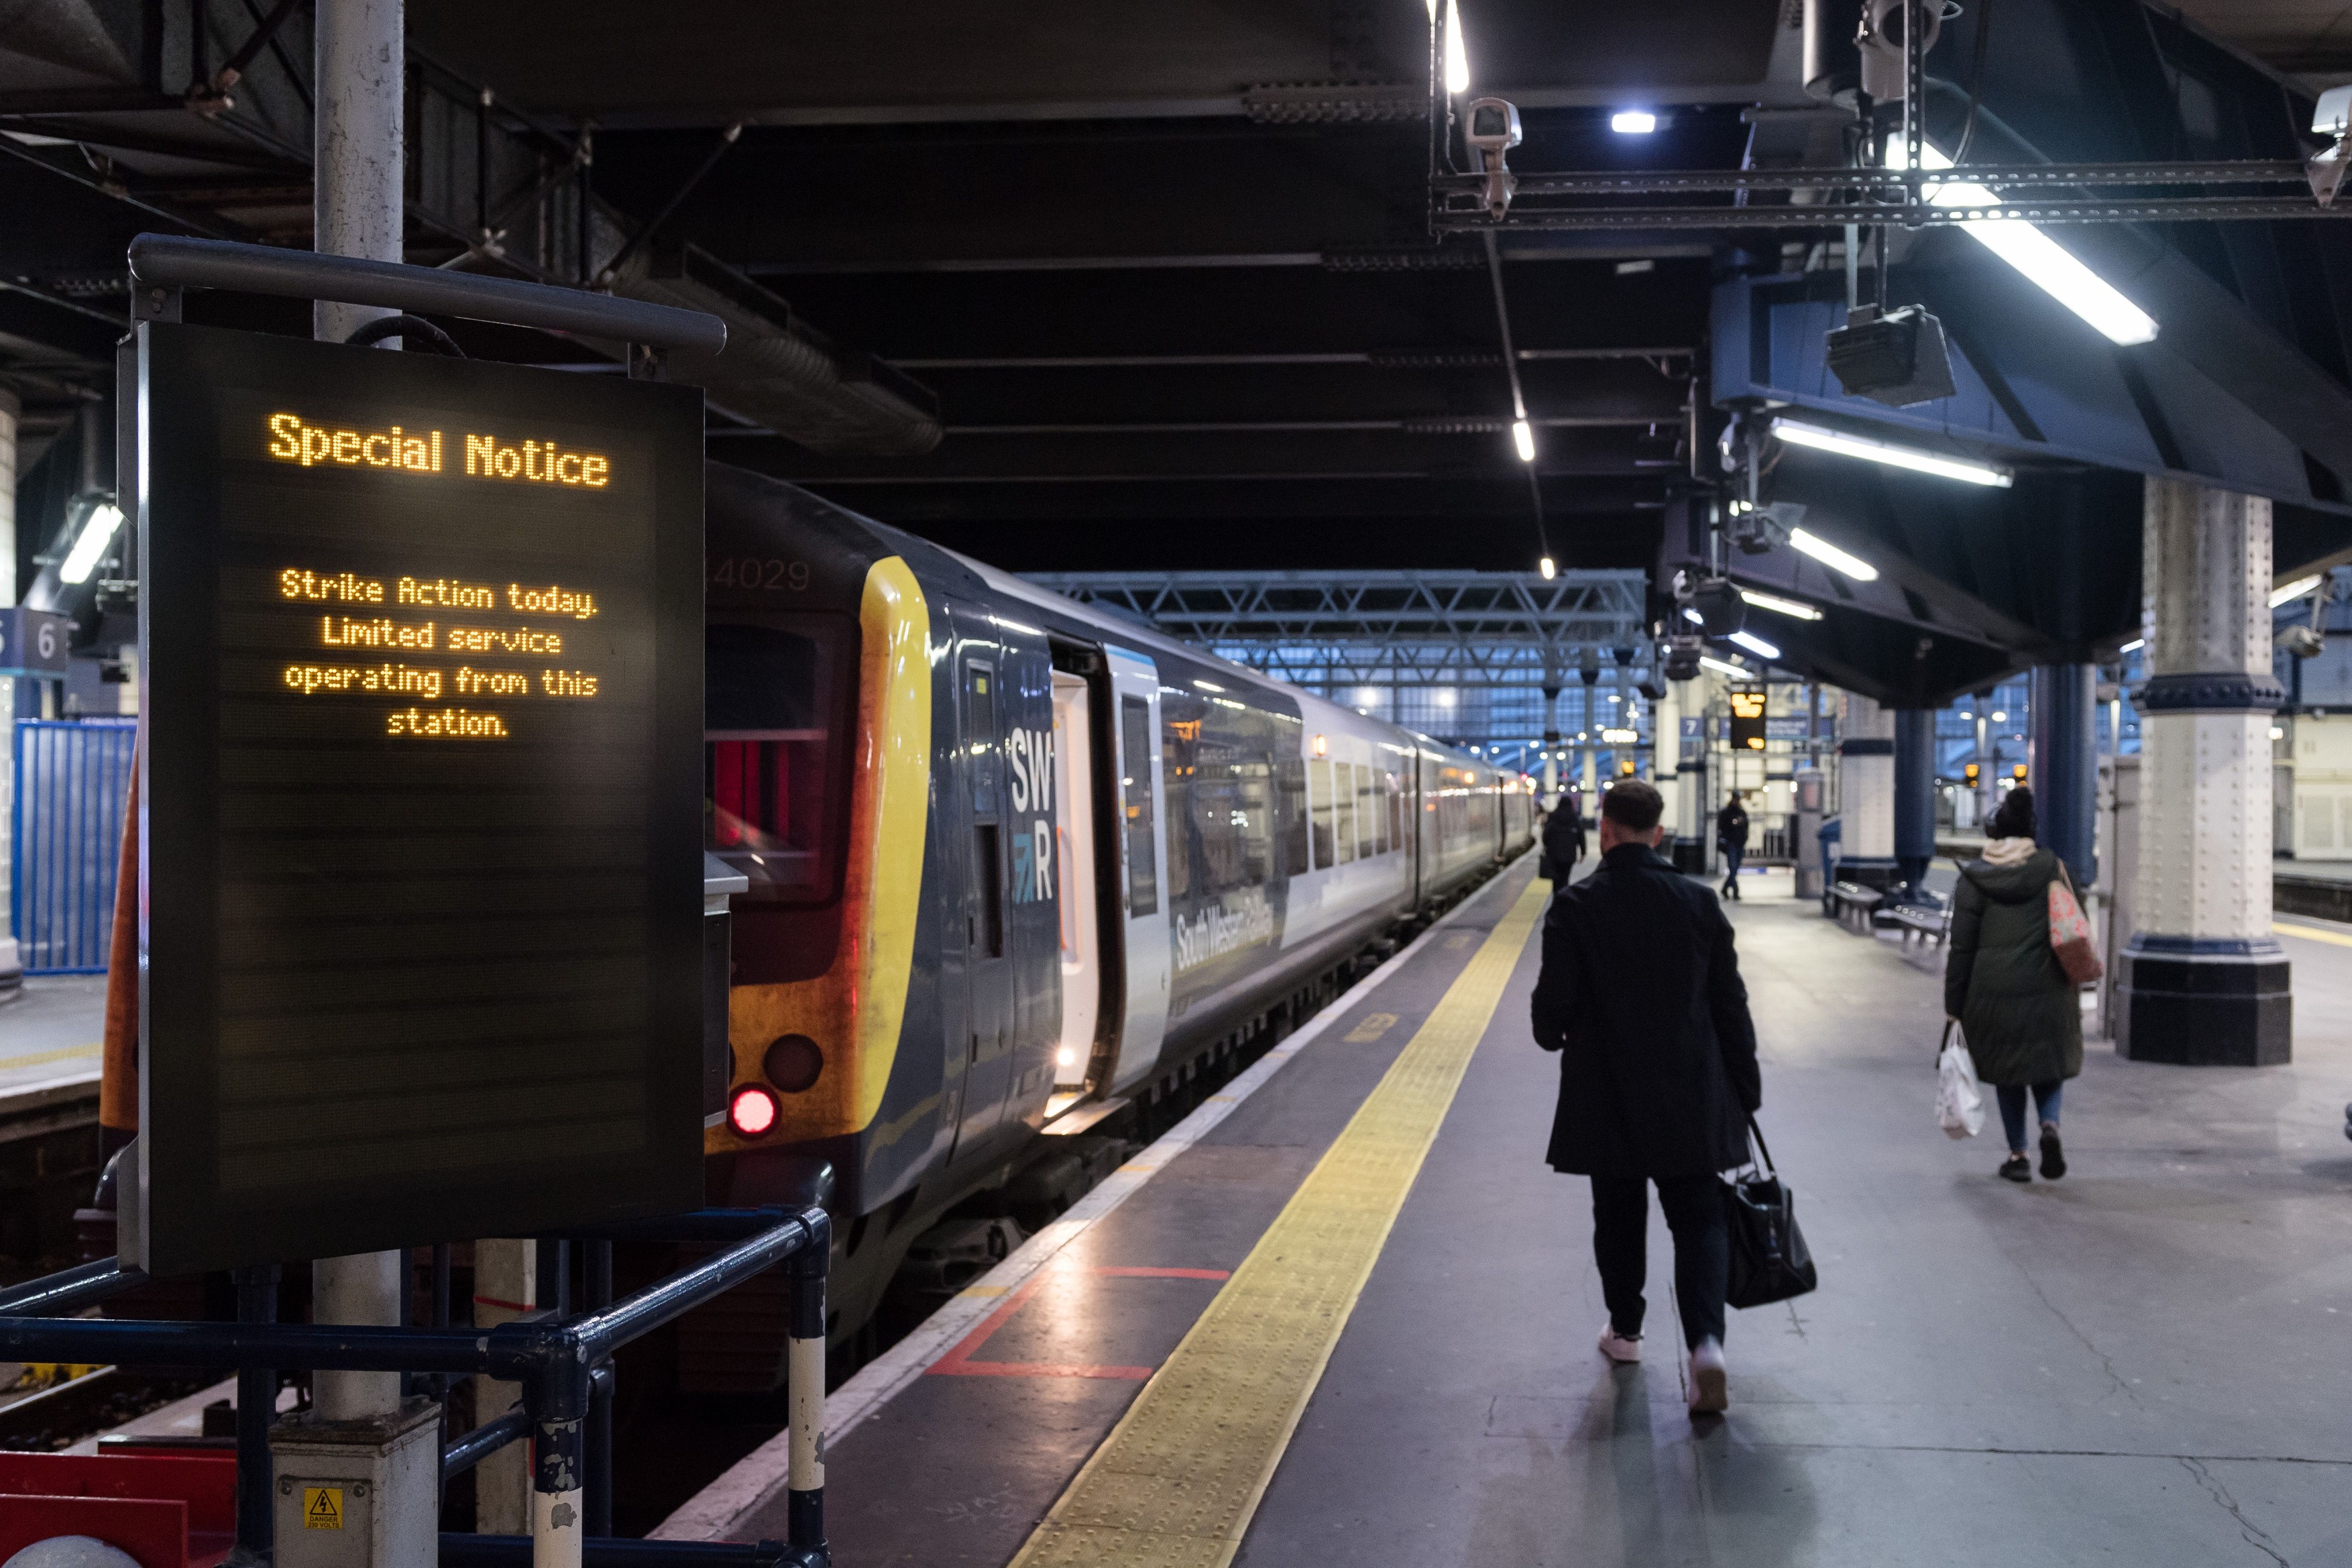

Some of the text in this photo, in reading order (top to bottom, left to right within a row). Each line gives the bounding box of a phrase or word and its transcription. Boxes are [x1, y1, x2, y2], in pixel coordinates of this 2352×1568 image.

[270, 414, 608, 486] Special Notice
[705, 557, 809, 592] 4029
[282, 569, 598, 619] Strike Action today.
[38, 622, 55, 659] 6
[323, 616, 562, 653] Limited service
[285, 663, 598, 698] operating from this
[388, 708, 508, 736] station.
[1685, 719, 1697, 736] 7
[1011, 727, 1052, 813] SW
